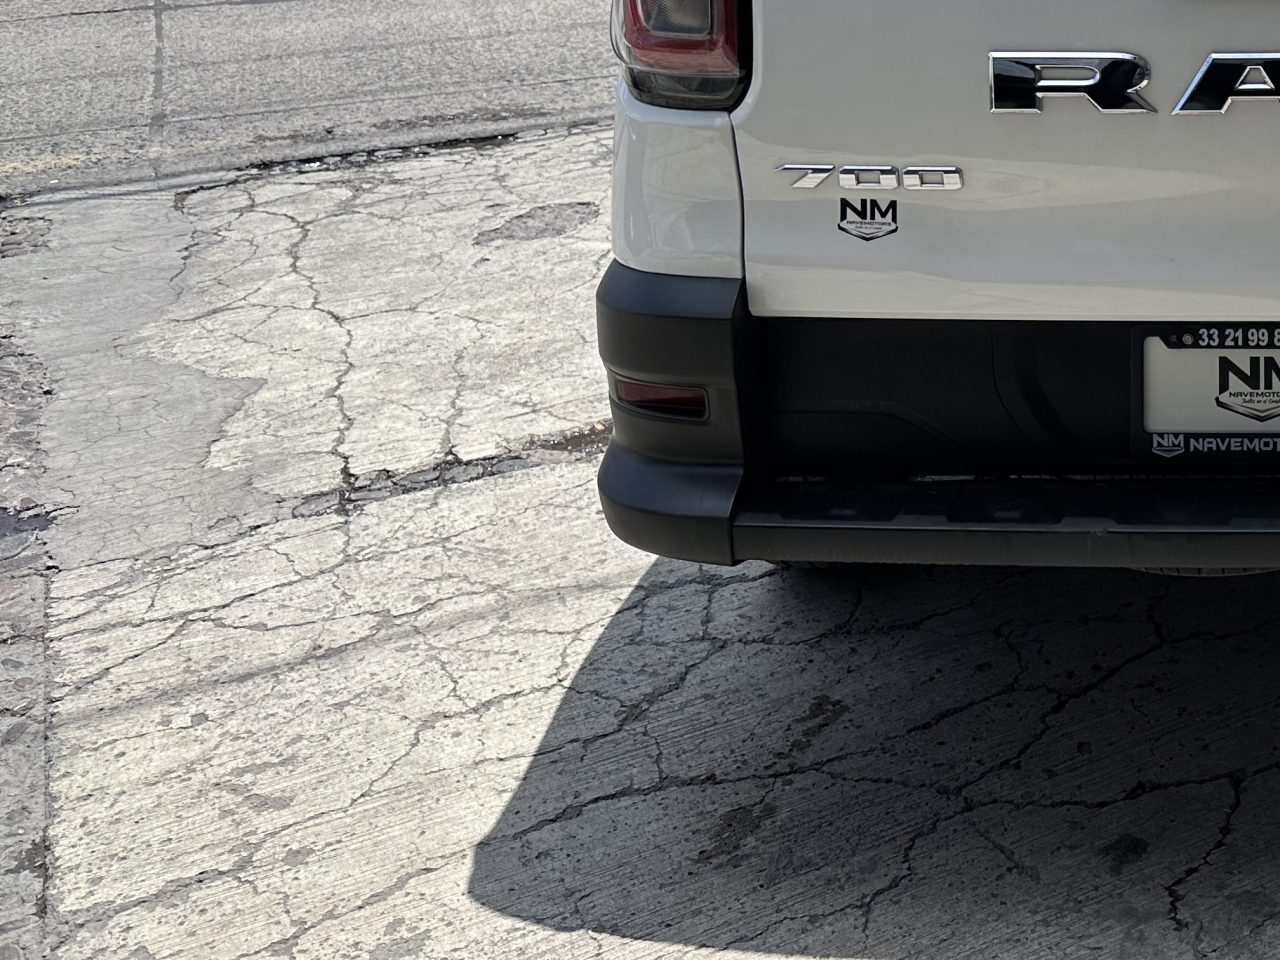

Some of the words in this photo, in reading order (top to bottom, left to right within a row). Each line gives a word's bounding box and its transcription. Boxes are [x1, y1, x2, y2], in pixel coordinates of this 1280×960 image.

[775, 163, 965, 191] 700
[839, 197, 898, 224] NM
[1198, 328, 1219, 346] 33
[1224, 328, 1243, 346] 21
[1247, 328, 1268, 346] 99
[1151, 433, 1185, 448] NM
